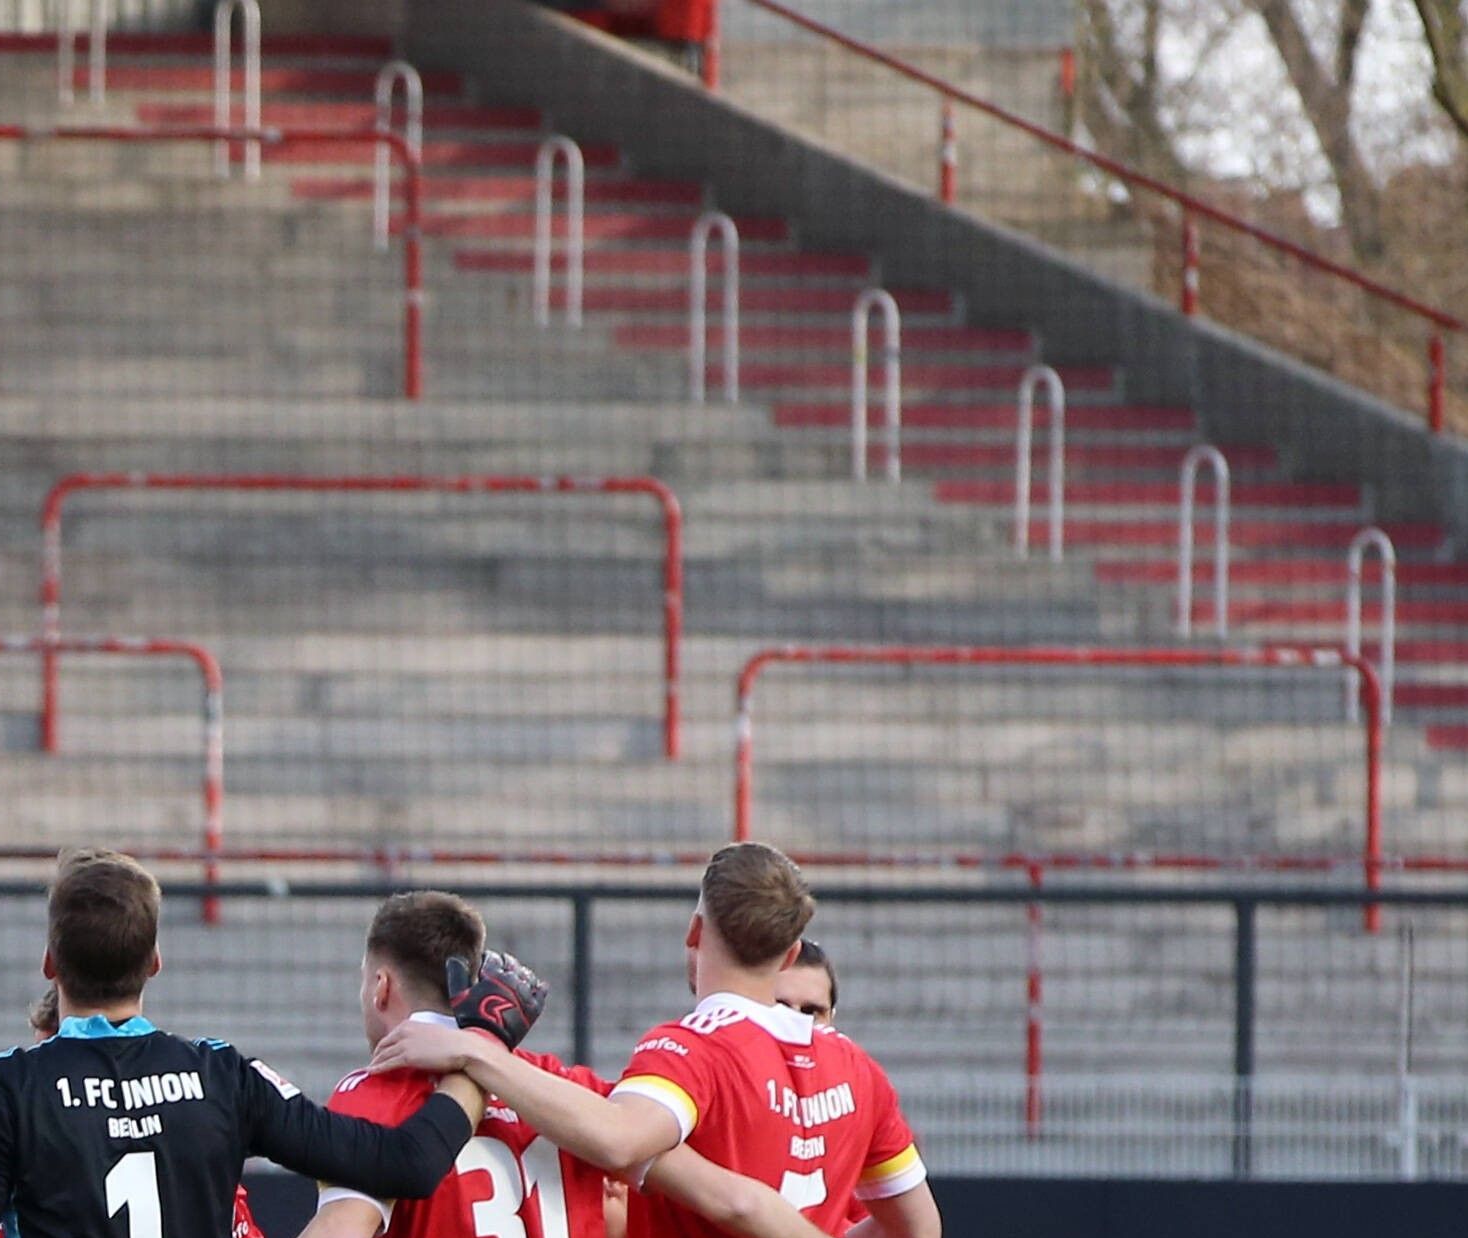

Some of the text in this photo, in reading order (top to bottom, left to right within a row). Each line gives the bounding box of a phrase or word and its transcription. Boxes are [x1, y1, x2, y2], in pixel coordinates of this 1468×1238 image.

[56, 1077, 82, 1108] 1.
[84, 1077, 118, 1109] FC
[767, 1079, 781, 1113] 1.
